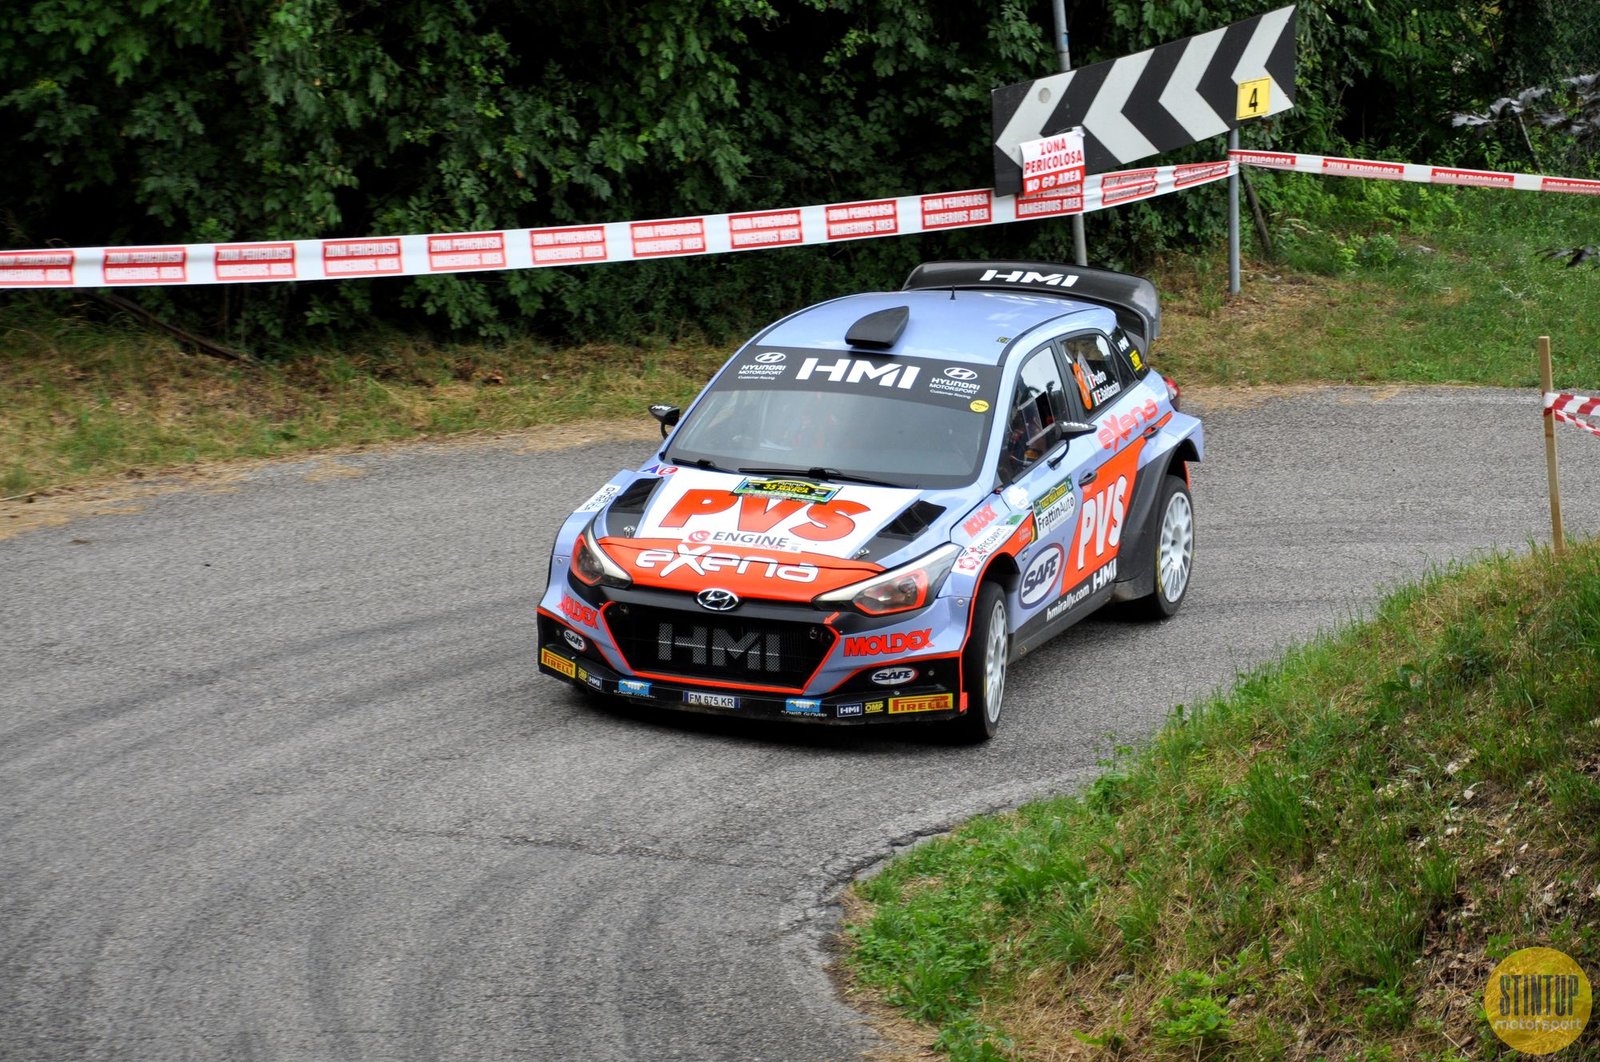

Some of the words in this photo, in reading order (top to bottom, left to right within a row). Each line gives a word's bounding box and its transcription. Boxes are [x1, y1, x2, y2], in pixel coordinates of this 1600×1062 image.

[1248, 87, 1258, 113] 4
[1039, 137, 1067, 156] ZONA
[1024, 149, 1083, 175] PERICOLOSA
[1026, 178, 1040, 193] NO
[1042, 175, 1056, 189] GO
[1057, 169, 1081, 186] AREA
[979, 269, 1080, 288] HMI
[740, 364, 788, 372] HYUNDAI
[795, 357, 921, 390] HMI
[928, 383, 978, 395] MOTORSPORT
[931, 377, 981, 391] HYUNDAI
[658, 487, 872, 542] PVS
[1077, 474, 1128, 571] PVS
[712, 530, 790, 548] ENGINE
[1022, 552, 1059, 598] SAFE
[1046, 584, 1090, 622] hmirally.com
[1092, 557, 1117, 594] HMI
[658, 622, 781, 672] HMI
[843, 627, 935, 657] MOLDEX
[542, 651, 575, 677] PIRELLI
[873, 669, 914, 682] SAFE
[689, 693, 702, 702] FM
[704, 695, 719, 705] 675
[720, 697, 734, 707] KR
[840, 705, 860, 715] HMI
[864, 703, 884, 712] OMP
[892, 695, 951, 712] PIRELLI
